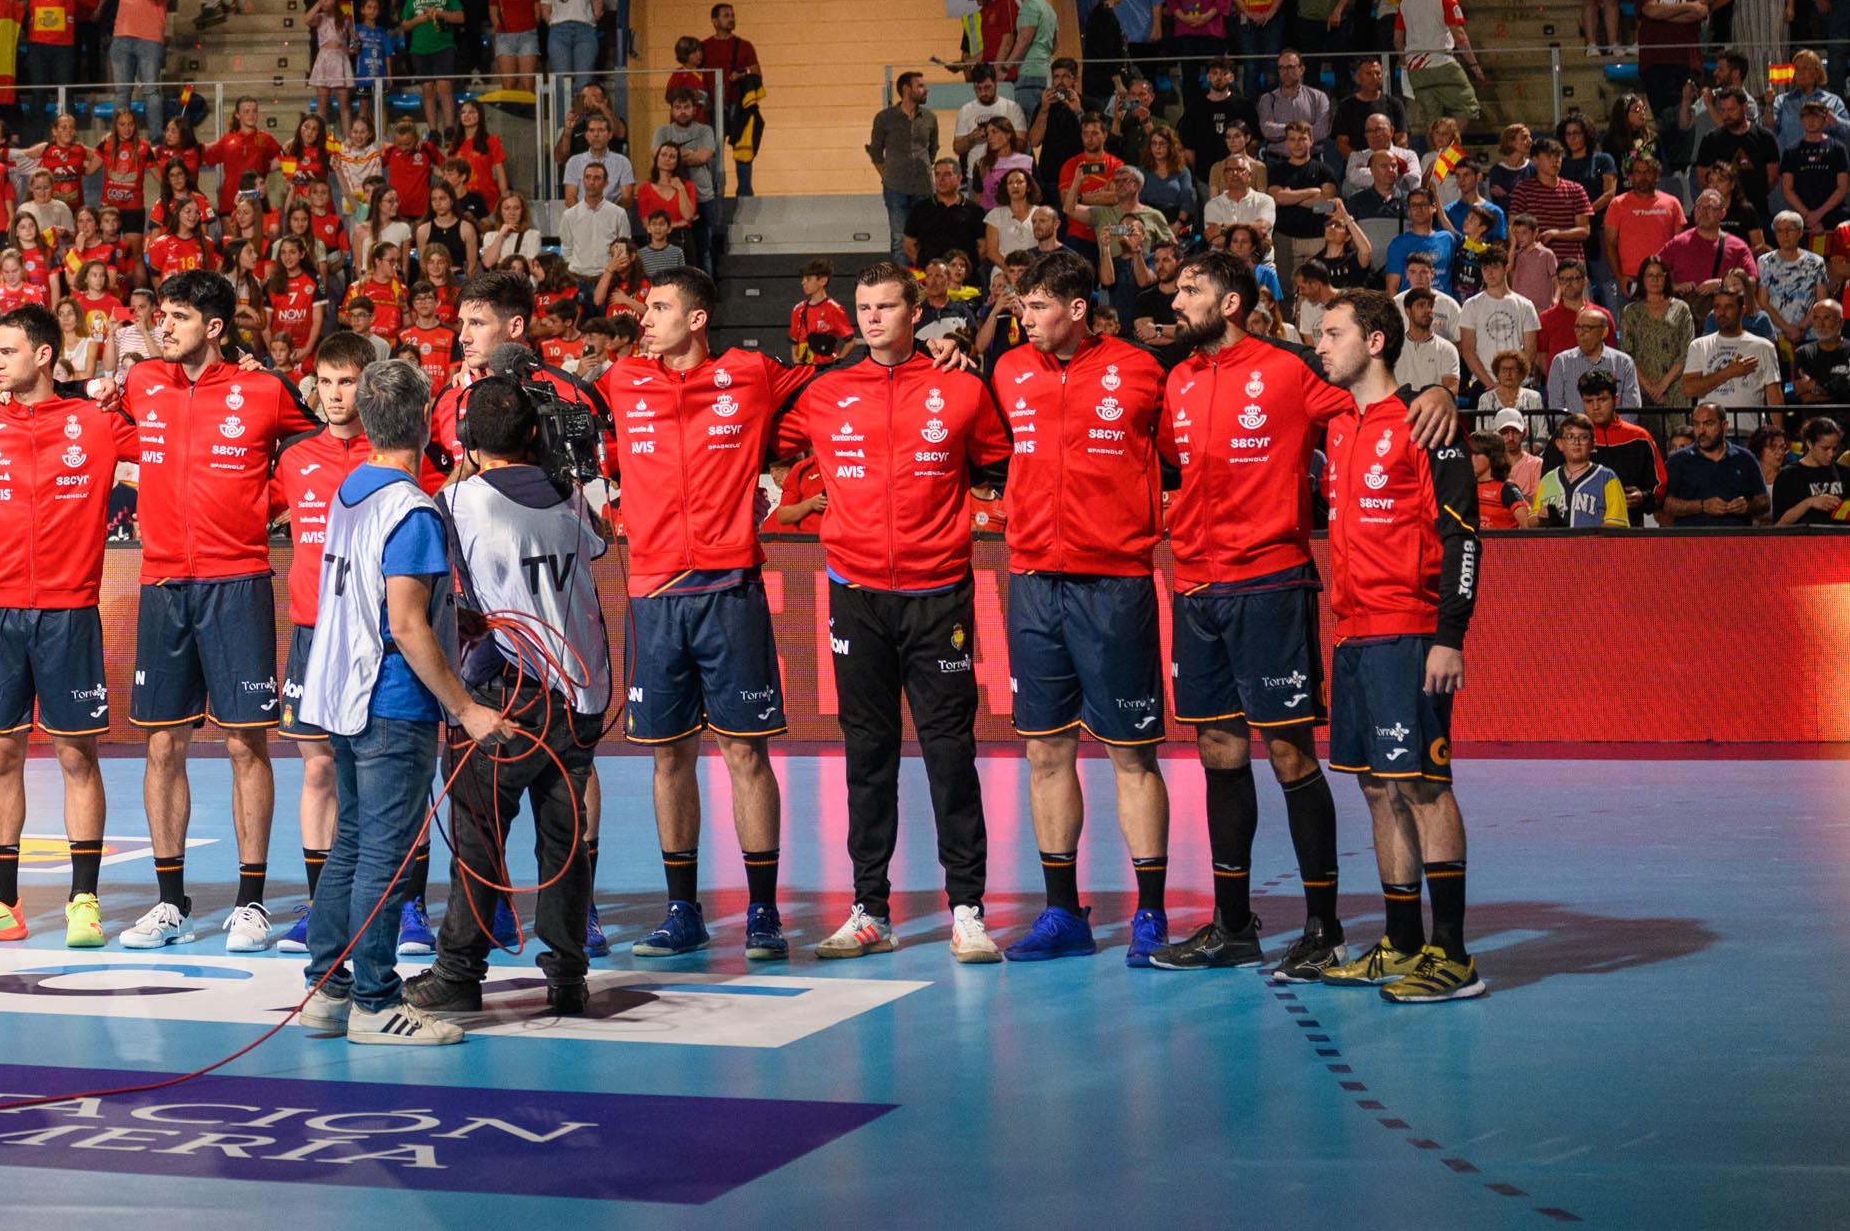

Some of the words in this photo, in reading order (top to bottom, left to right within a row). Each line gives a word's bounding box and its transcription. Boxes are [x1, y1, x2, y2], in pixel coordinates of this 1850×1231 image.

[289, 292, 298, 305] 7
[278, 309, 307, 320] NOVI
[549, 347, 561, 356] 10
[627, 408, 655, 417] Santander
[140, 419, 166, 428] Santander
[708, 425, 741, 435] sacyr
[1089, 429, 1124, 440] sacyr
[832, 432, 864, 441] Santander
[632, 441, 654, 453] AVIS
[1231, 438, 1270, 448] sacyr
[212, 445, 247, 456] sacyr
[142, 452, 162, 463] AVIS
[916, 452, 948, 461] sacyr
[837, 466, 864, 477] AVIS
[56, 475, 89, 485] sacyr
[1360, 498, 1394, 508] sacyr
[300, 532, 324, 543] AVIS
[522, 552, 575, 595] TV
